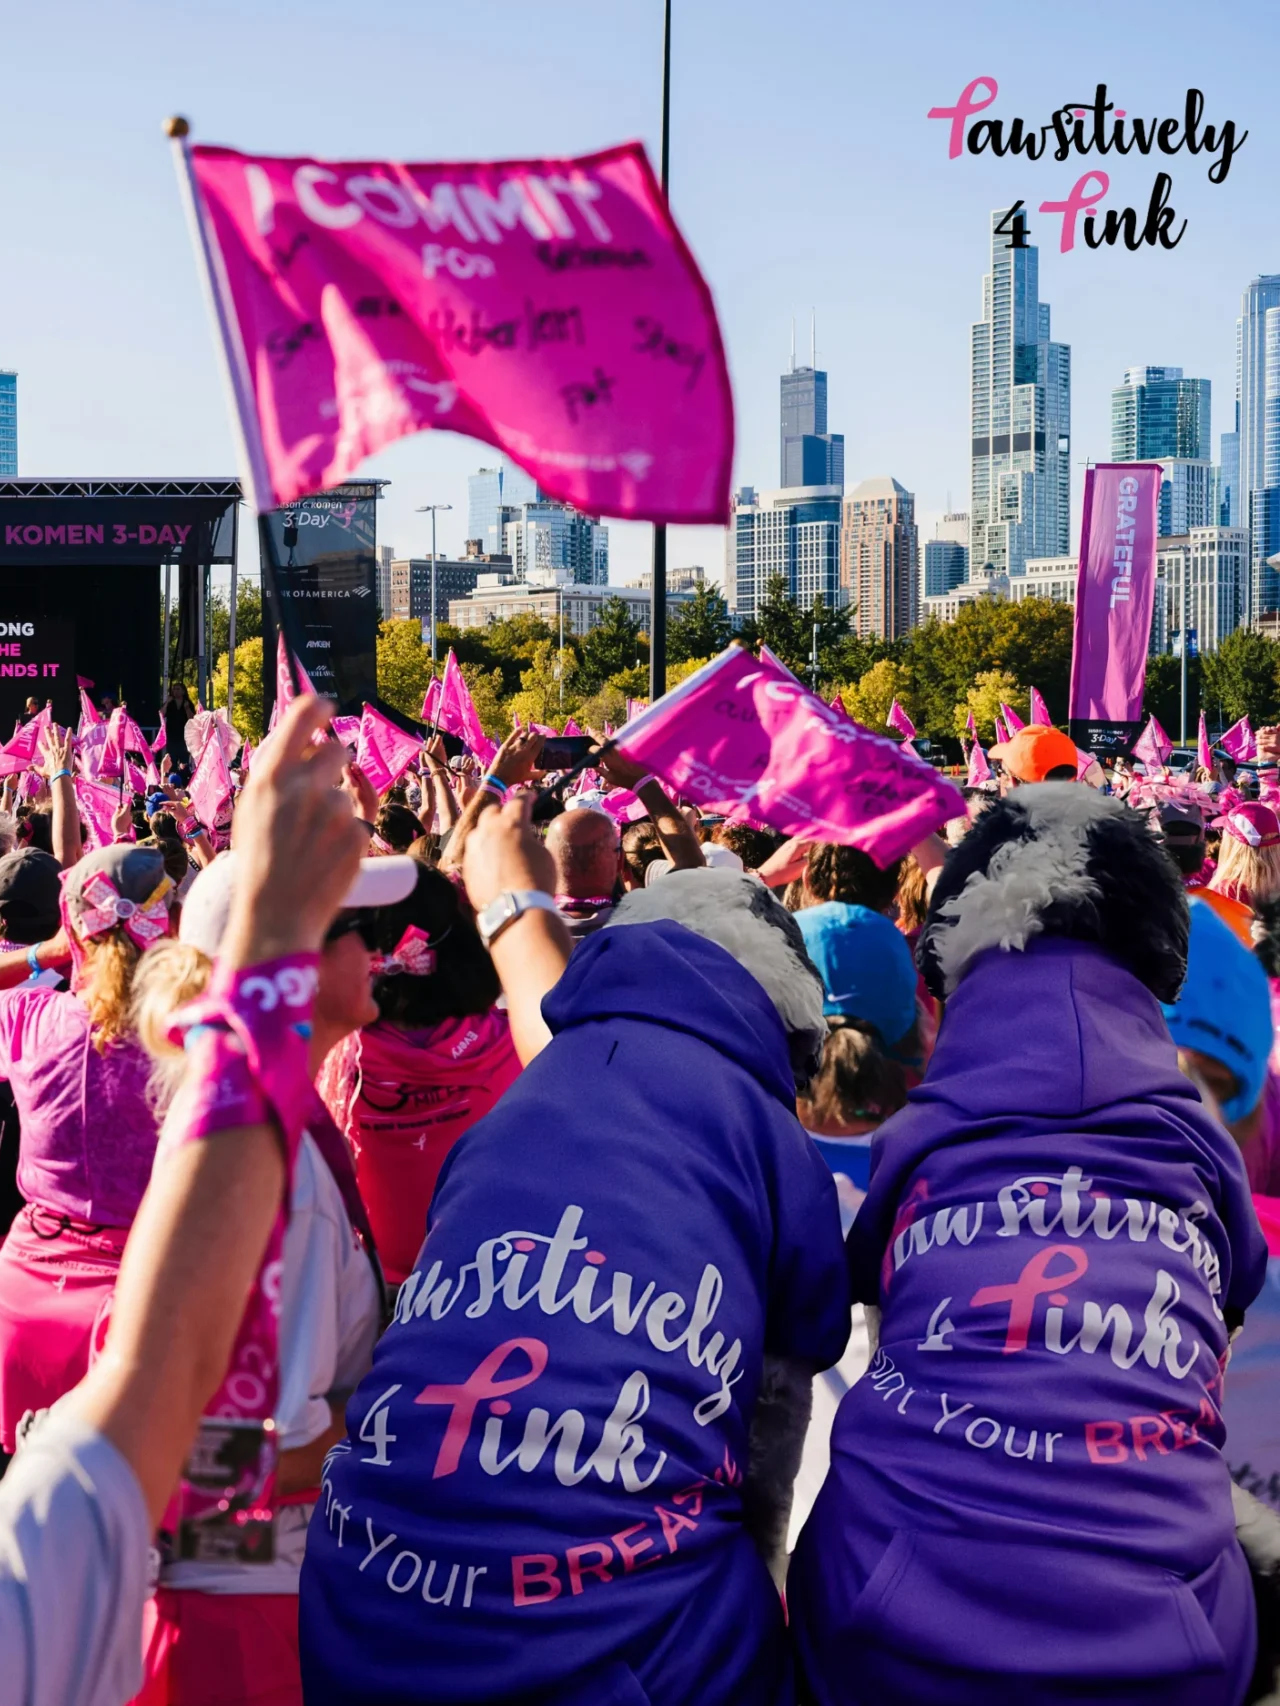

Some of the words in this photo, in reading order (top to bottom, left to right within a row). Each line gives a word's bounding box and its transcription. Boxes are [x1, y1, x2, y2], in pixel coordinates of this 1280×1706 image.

[292, 164, 612, 244] COMMIT
[5, 524, 105, 545] KOMEN
[112, 524, 193, 545] 3-DAY
[1110, 476, 1140, 609] GRATEFUL
[266, 590, 291, 598] BNK
[293, 590, 305, 598] OF
[307, 590, 351, 598] AMERICA
[42, 664, 60, 678] IT
[306, 640, 331, 649] AMGEN
[451, 1030, 479, 1060] Every
[393, 1204, 745, 1427] awsitively
[358, 1383, 403, 1467] 4
[932, 1392, 1063, 1464] Your
[358, 1516, 488, 1609] Your
[510, 1484, 706, 1608] BREAS
